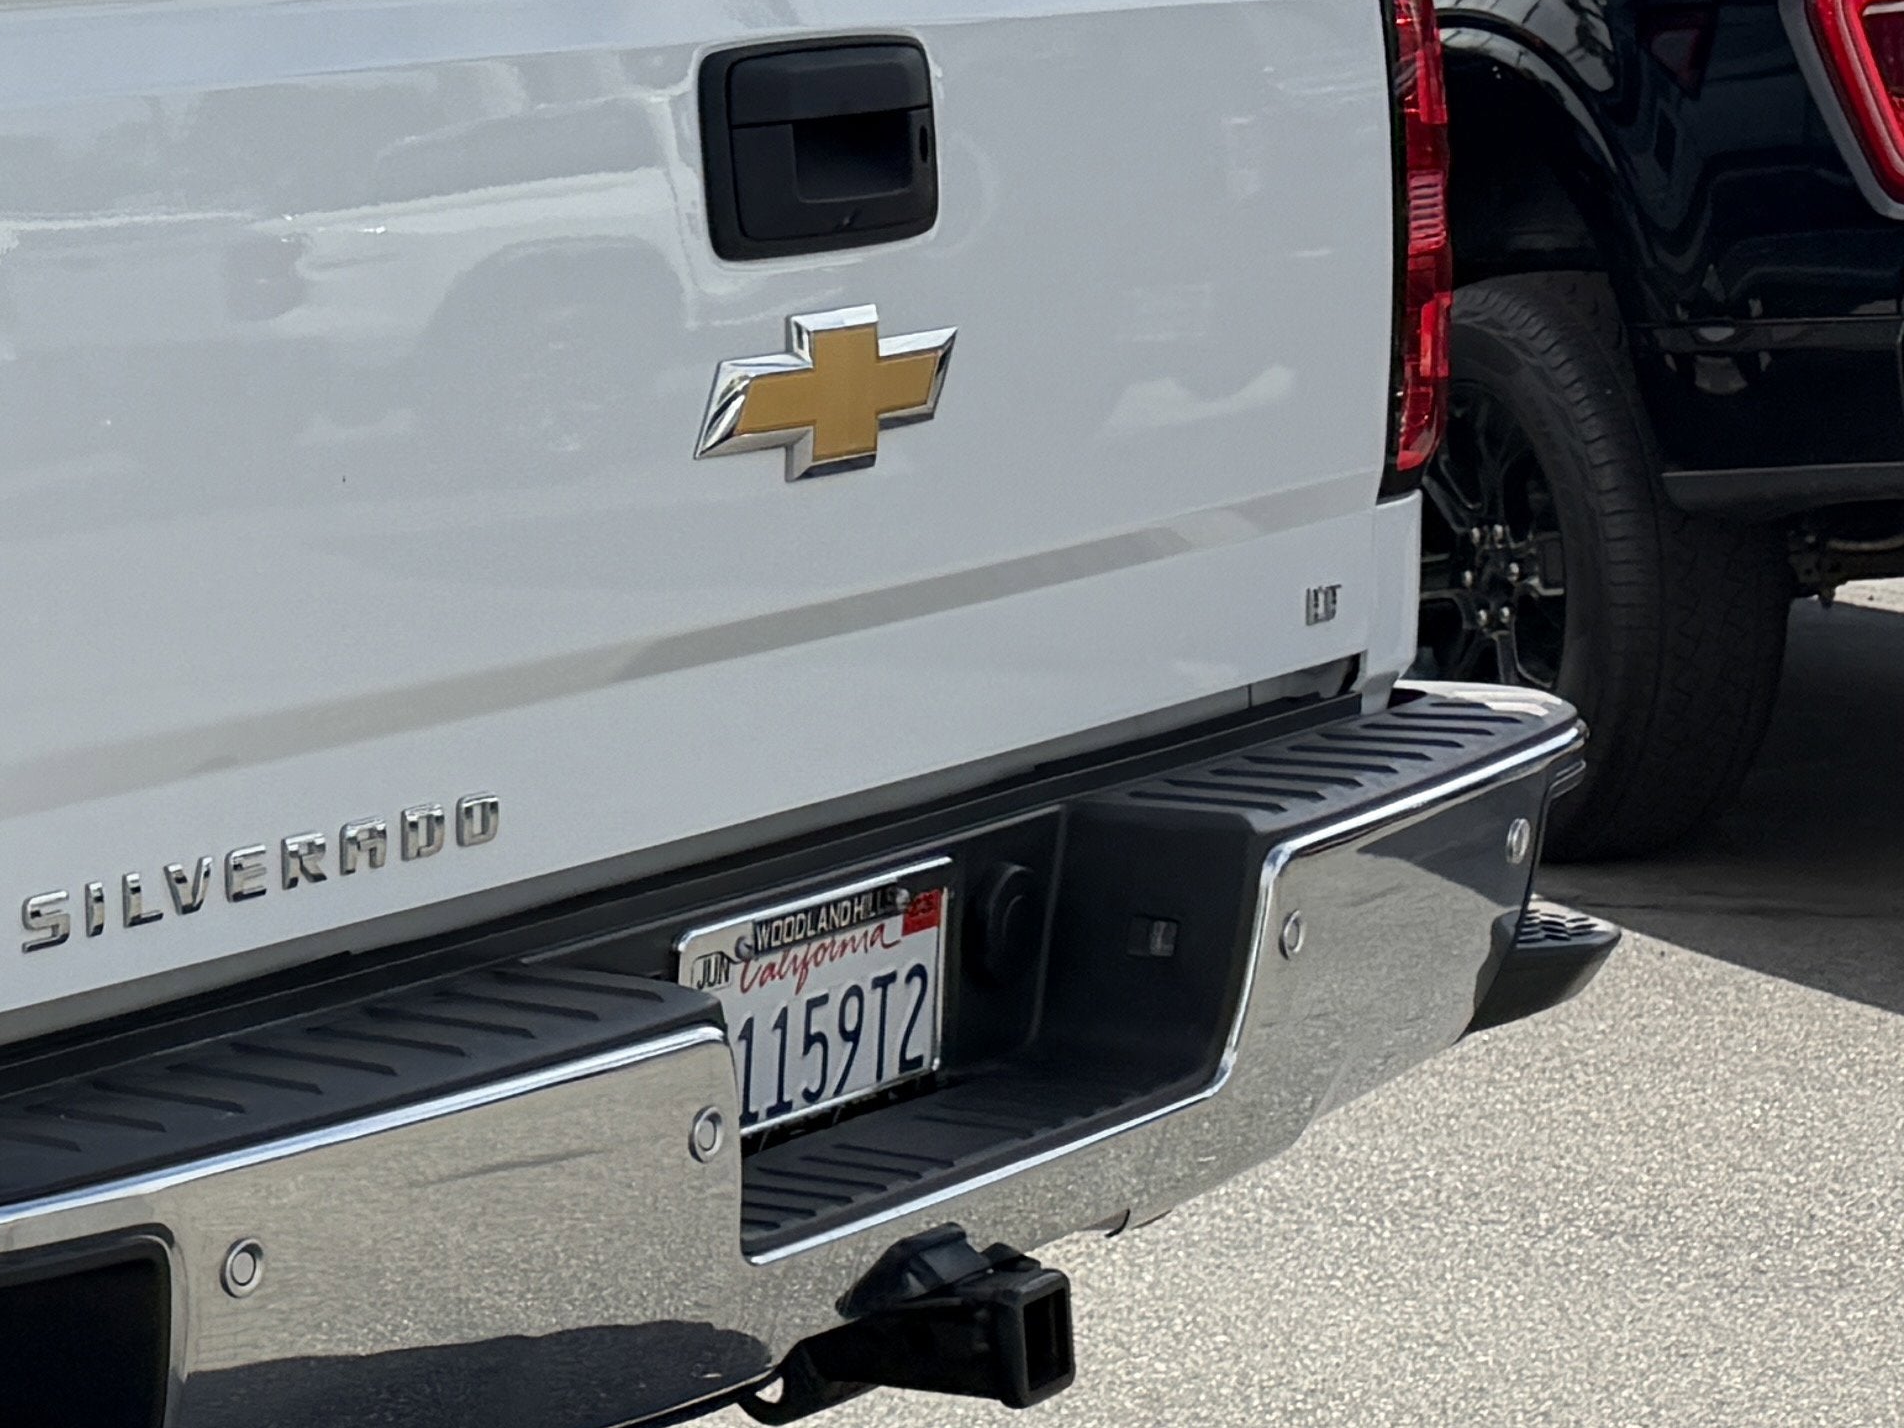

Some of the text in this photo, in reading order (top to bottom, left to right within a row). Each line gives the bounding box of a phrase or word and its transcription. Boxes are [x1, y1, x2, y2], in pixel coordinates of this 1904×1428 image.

[20, 790, 500, 955] SILVERADO
[755, 899, 852, 952] WOODLAND
[697, 954, 730, 990] JUN
[740, 923, 902, 995] California
